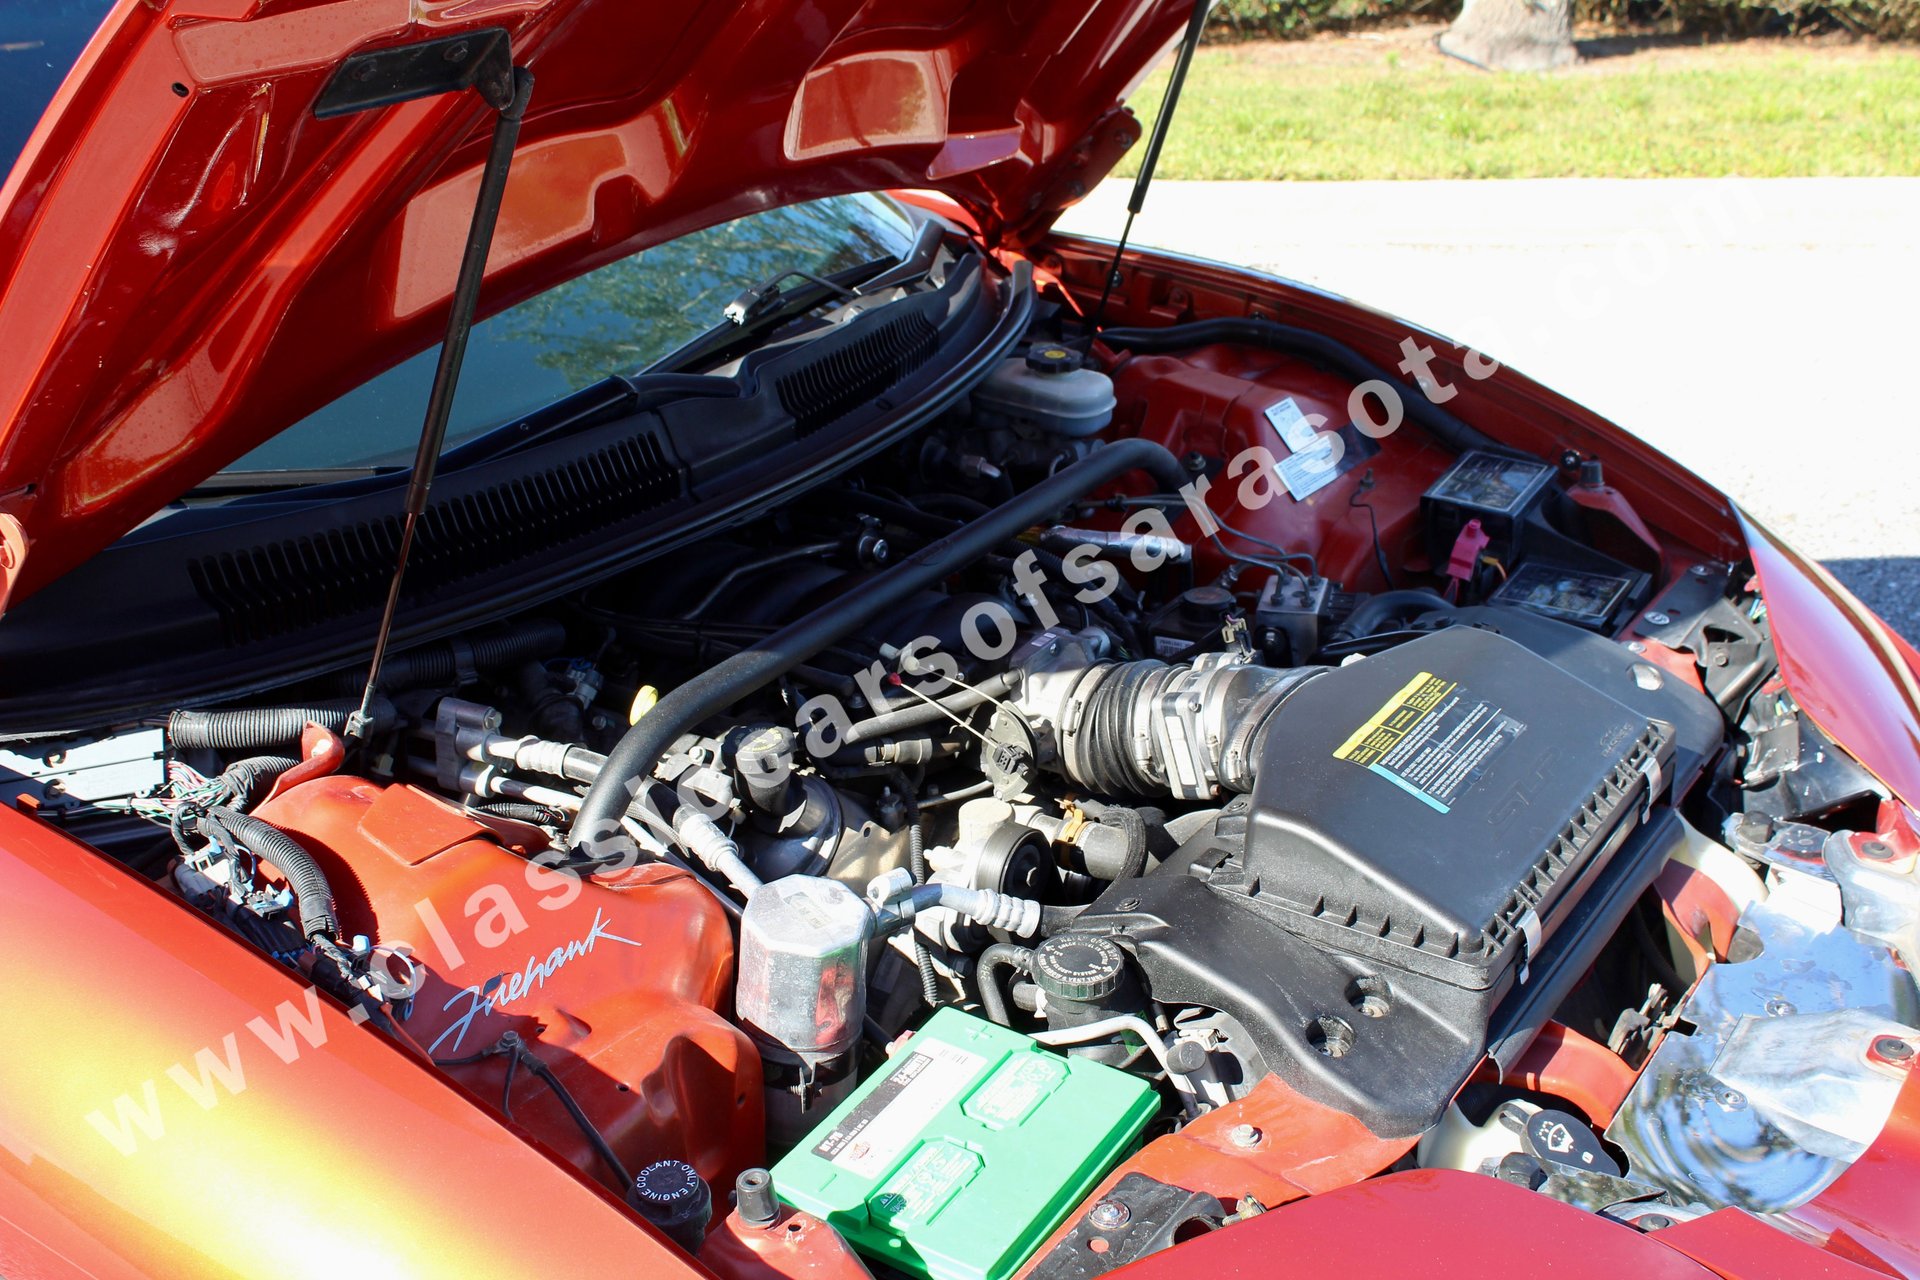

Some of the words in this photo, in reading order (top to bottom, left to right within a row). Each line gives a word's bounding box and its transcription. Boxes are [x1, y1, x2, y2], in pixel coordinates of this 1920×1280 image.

[428, 907, 642, 1055] Firehawk
[636, 1160, 679, 1188] COOLANT
[681, 1164, 697, 1187] ONLY
[642, 1188, 689, 1201] ENGINE
